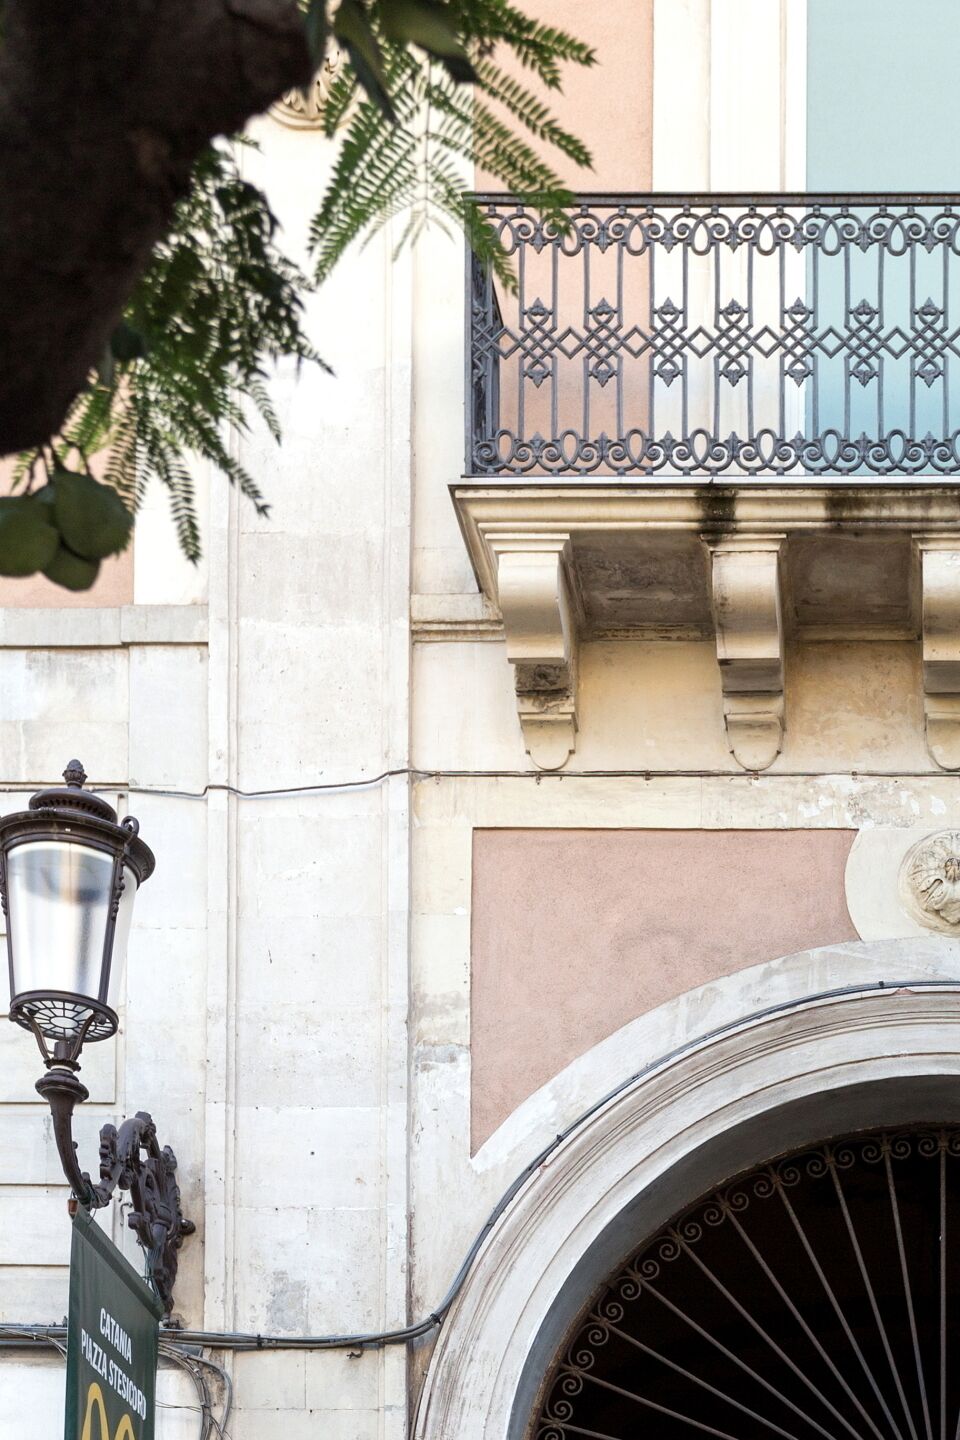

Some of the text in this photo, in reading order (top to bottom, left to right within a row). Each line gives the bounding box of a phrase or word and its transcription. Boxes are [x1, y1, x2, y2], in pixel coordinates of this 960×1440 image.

[100, 1308, 132, 1364] CATANIA
[81, 1328, 147, 1420] PIAZZA STESICORO
